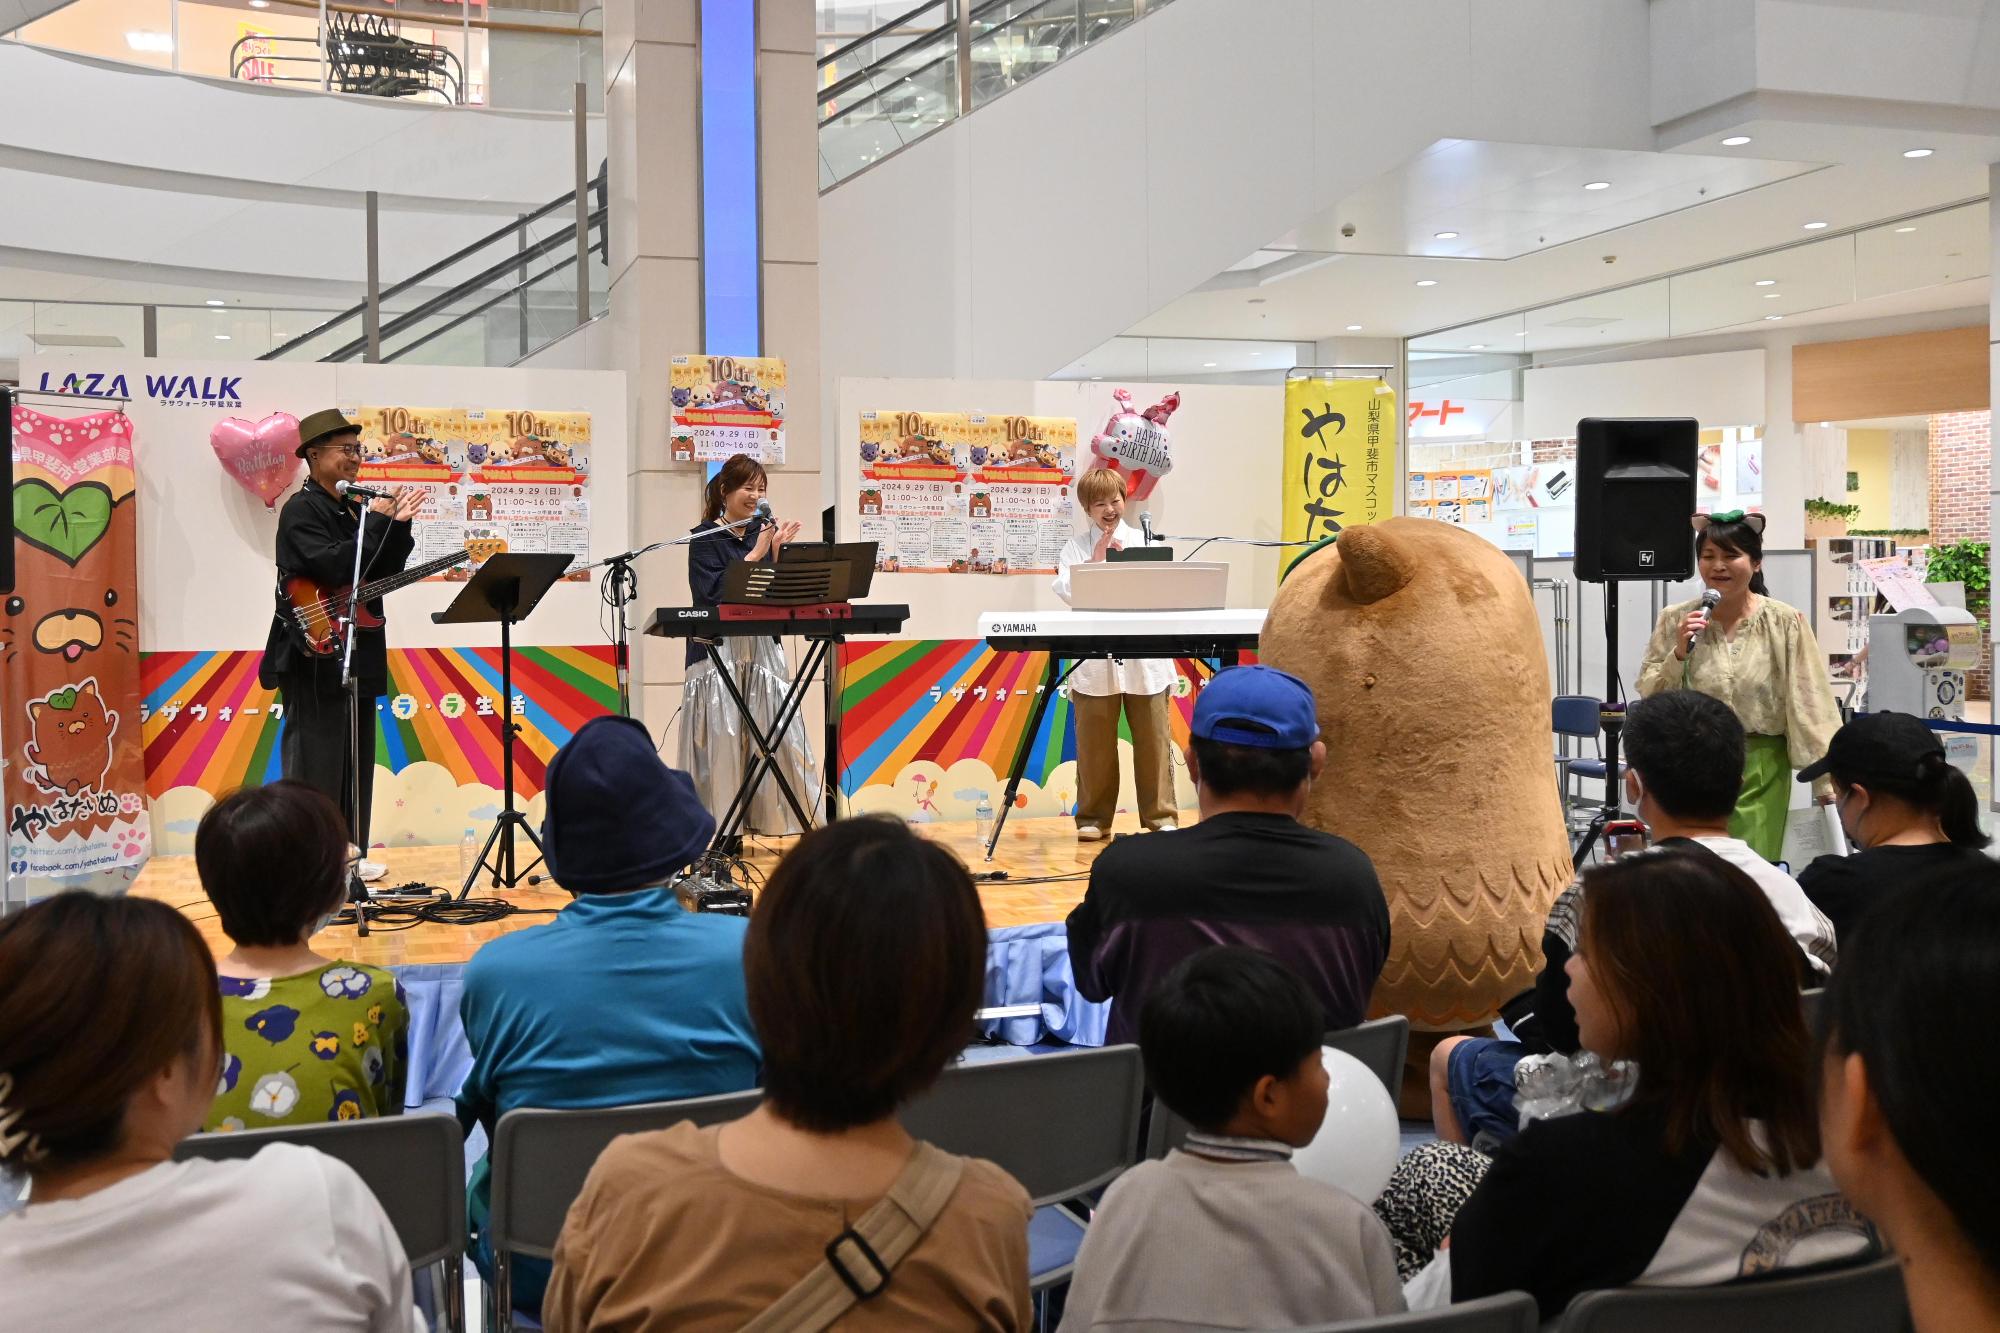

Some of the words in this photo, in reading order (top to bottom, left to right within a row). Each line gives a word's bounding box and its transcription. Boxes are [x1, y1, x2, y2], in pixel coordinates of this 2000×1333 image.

[709, 357, 751, 382] 10th
[40, 372, 130, 398] LAZA
[147, 375, 242, 400] WALK
[381, 407, 427, 435] 10th
[507, 409, 552, 438] 10th
[896, 411, 937, 437] 10th
[1005, 415, 1044, 441] 10th
[1134, 427, 1162, 451] HAPPY
[678, 610, 709, 619] CASIO
[1002, 623, 1037, 634] YAMAHA
[11, 793, 118, 842] やはたいぬ
